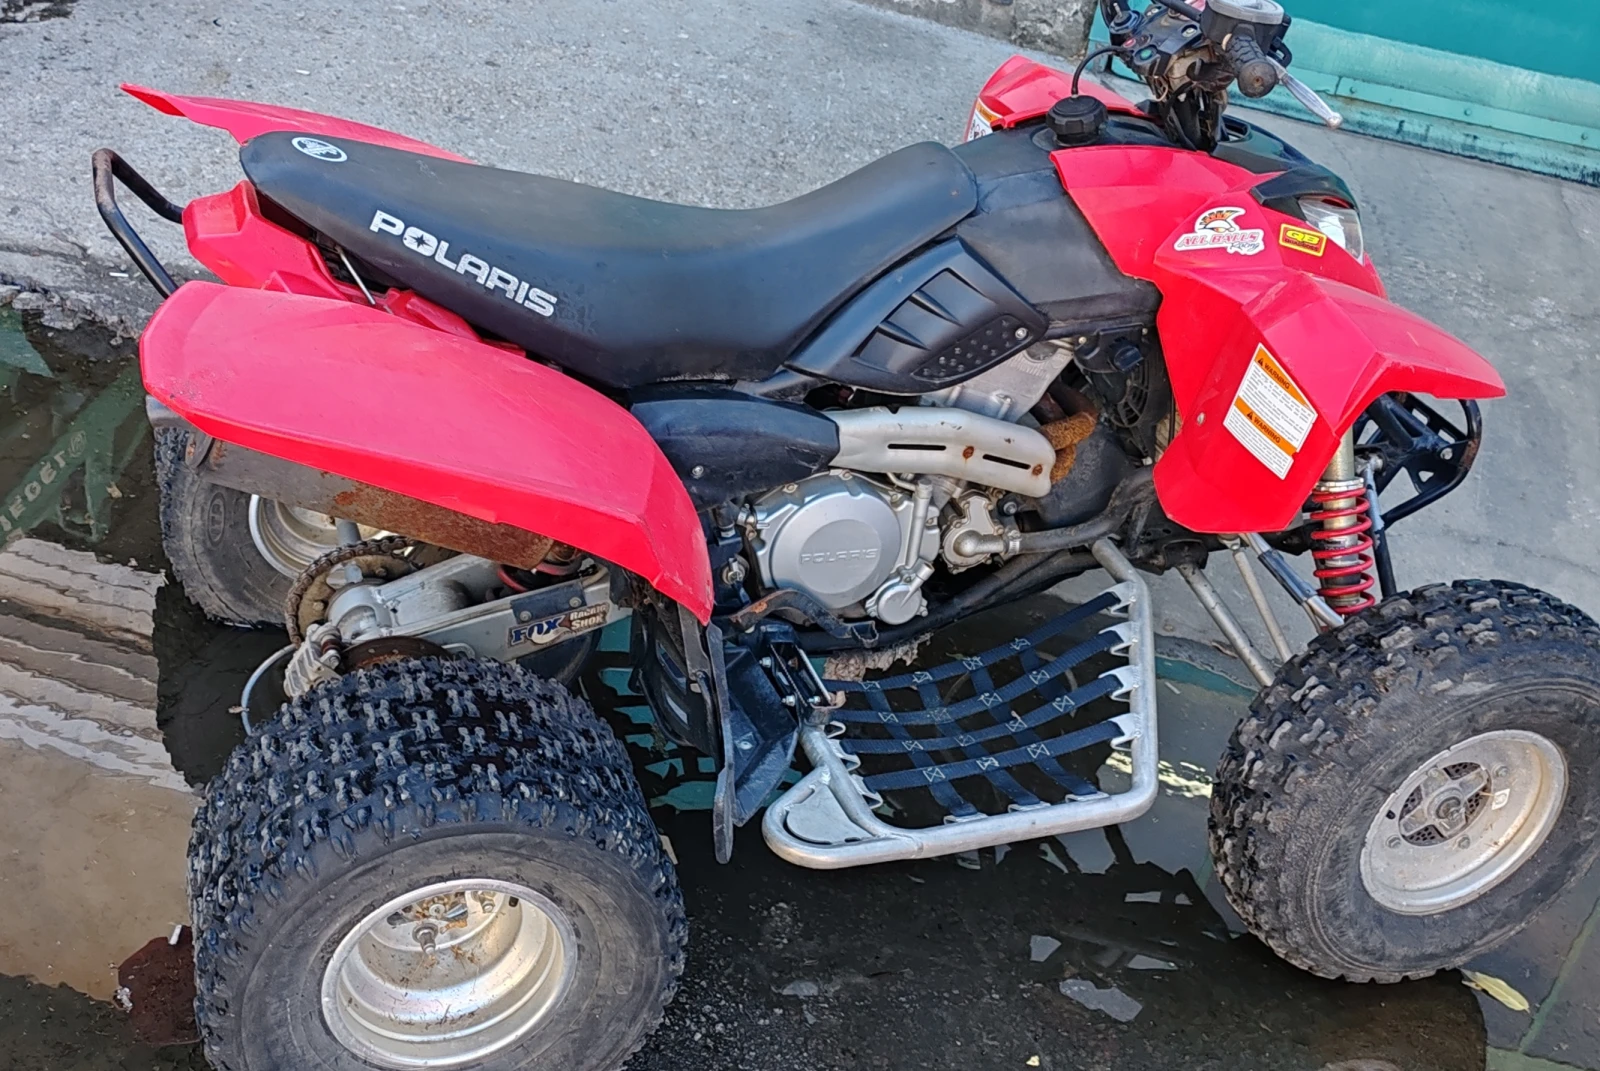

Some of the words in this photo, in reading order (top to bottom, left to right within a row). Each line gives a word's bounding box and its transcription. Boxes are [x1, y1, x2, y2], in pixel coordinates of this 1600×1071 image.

[1178, 235, 1208, 248] ALL
[1209, 232, 1260, 245] BALLS
[1229, 241, 1260, 252] Racing
[1286, 230, 1320, 245] QB
[369, 210, 557, 317] POLARIS
[1264, 363, 1291, 390] WARNING
[1253, 416, 1281, 444] WARNING
[800, 548, 879, 565] POLARIS
[511, 614, 566, 645] FOX
